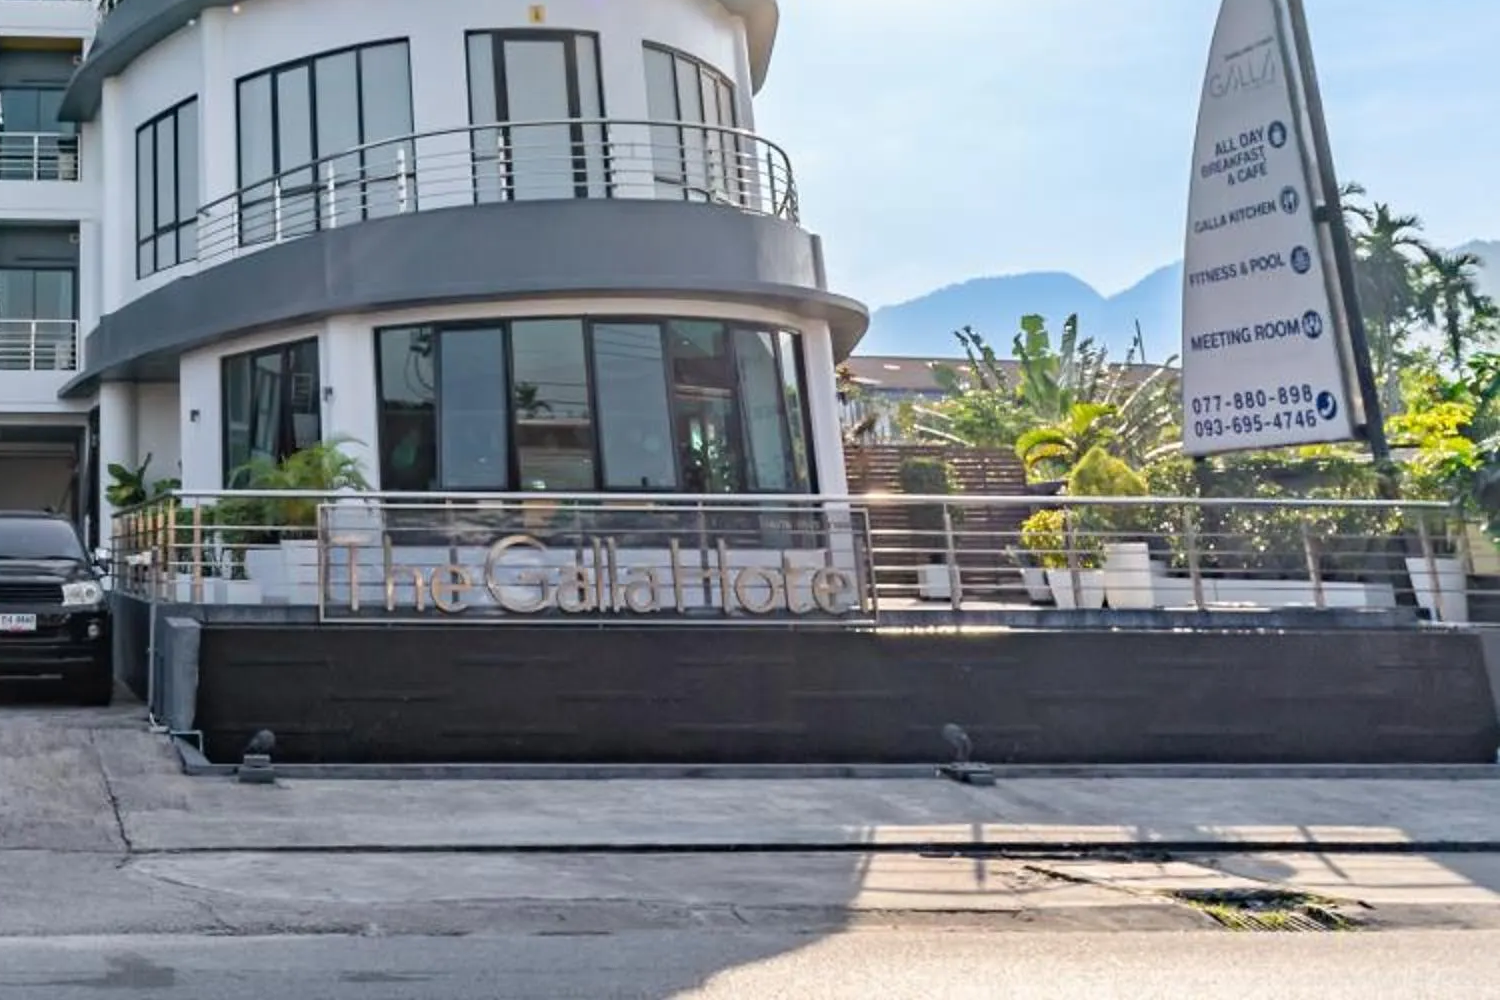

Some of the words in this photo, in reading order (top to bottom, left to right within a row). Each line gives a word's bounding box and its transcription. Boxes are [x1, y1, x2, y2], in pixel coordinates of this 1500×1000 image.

[1215, 138, 1237, 157] ALL
[1239, 126, 1265, 148] DAY
[1201, 145, 1266, 179] BREAKFAST
[1229, 199, 1277, 223] KITCHEN
[1189, 263, 1237, 287] FITNESS
[1239, 261, 1248, 276] &
[1251, 252, 1286, 273] POOL
[1191, 326, 1252, 351] MEETING
[1255, 318, 1300, 341] ROOM
[1192, 383, 1313, 415] 077-880-898
[1195, 409, 1317, 438] 093-695-4746
[331, 534, 473, 613] The
[484, 533, 661, 614] Galla
